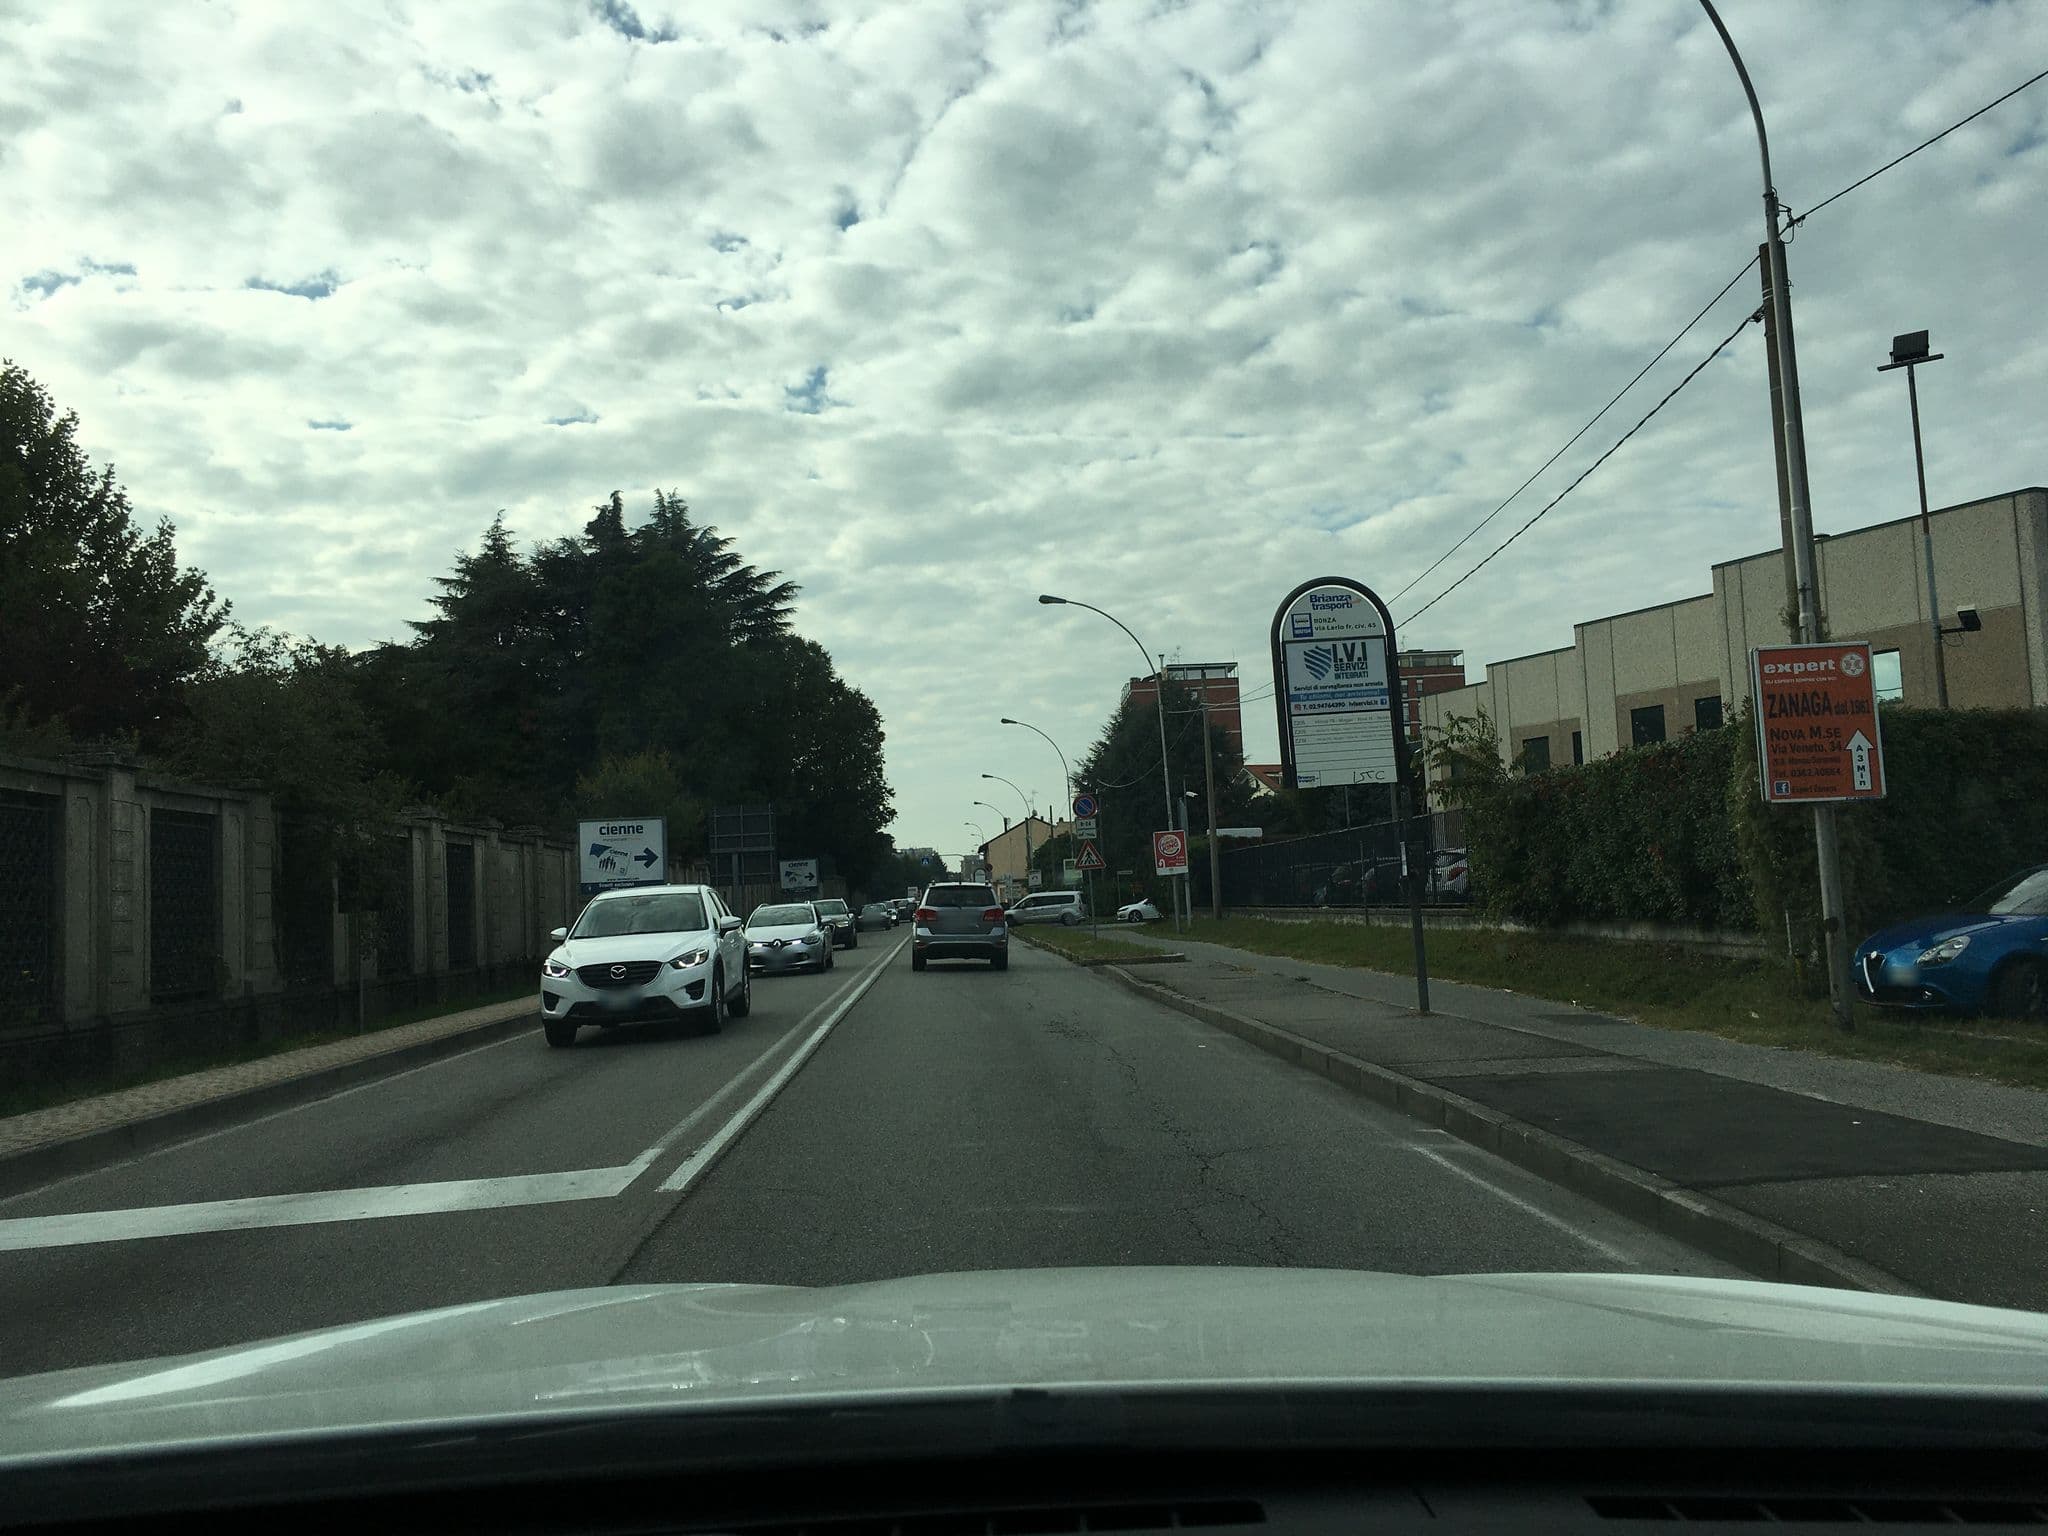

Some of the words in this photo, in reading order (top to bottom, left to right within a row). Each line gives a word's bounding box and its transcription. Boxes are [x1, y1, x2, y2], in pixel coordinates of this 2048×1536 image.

[1310, 594, 1352, 603] Brianza
[1312, 602, 1352, 611] trasporti
[1332, 642, 1368, 663] I.V.I
[1334, 662, 1368, 672] SERVIZI
[1763, 659, 1836, 674] expert
[1334, 671, 1368, 680] INTEGRATI
[1320, 682, 1352, 690] sorveglianza
[1768, 690, 1832, 718] ZANAGA
[1772, 744, 1786, 754] Via
[599, 824, 644, 836] cienne
